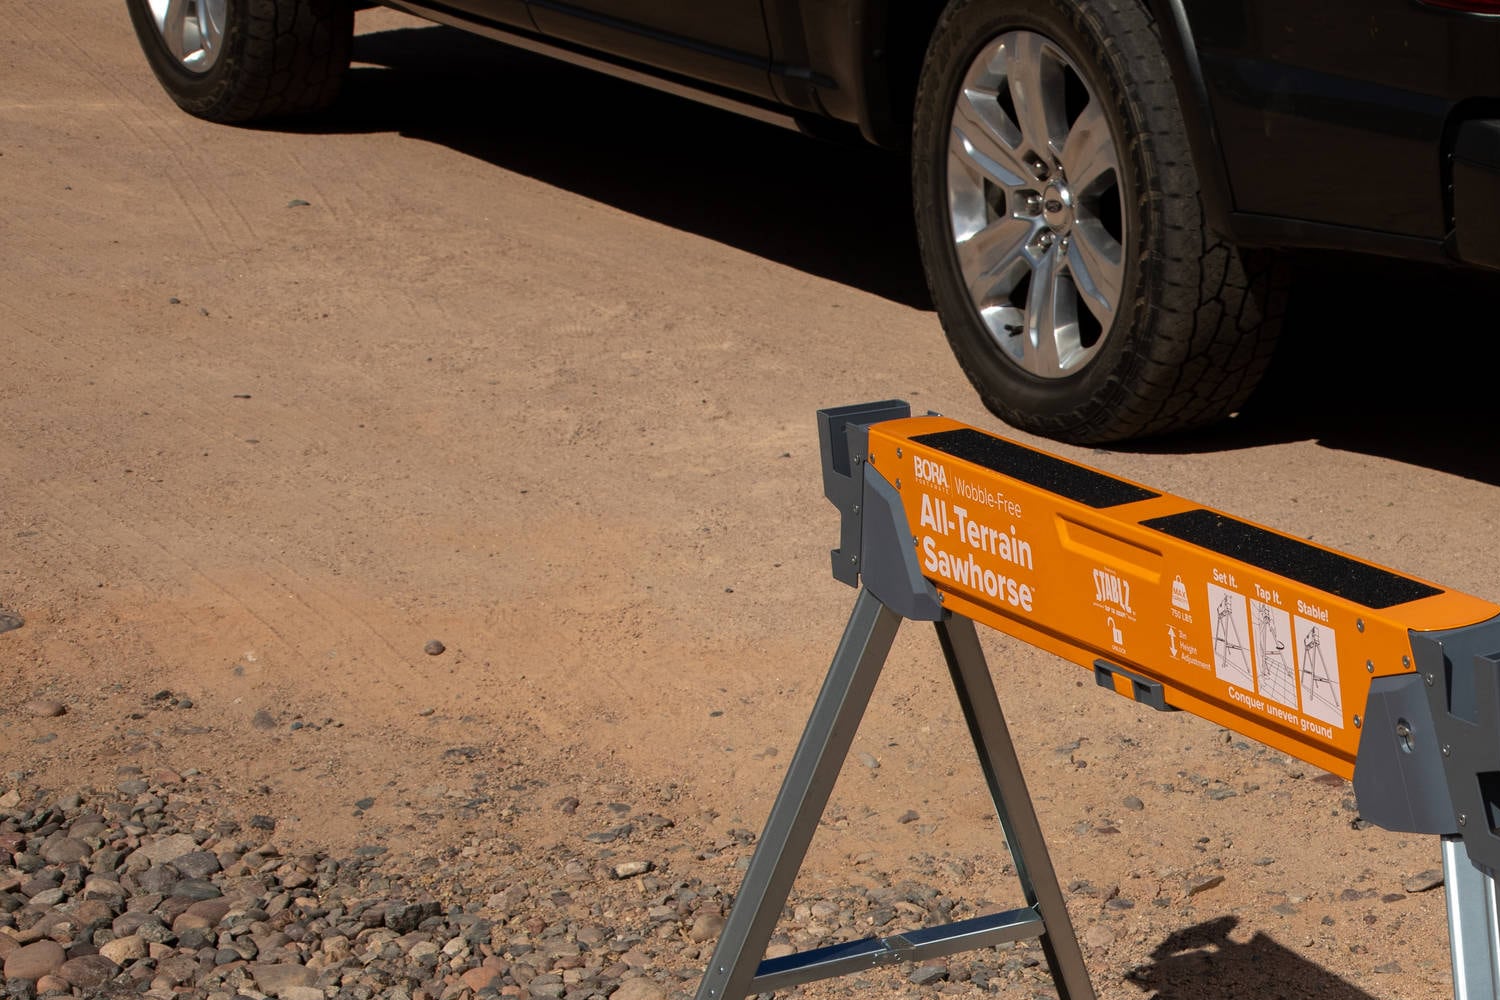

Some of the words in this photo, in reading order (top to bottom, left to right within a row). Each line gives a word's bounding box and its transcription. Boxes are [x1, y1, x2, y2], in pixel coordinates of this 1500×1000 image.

[913, 455, 948, 488] BORA
[954, 476, 1022, 518] Wobble-Free
[920, 493, 1033, 570] All-Terrain
[1212, 568, 1228, 585] Set
[1229, 574, 1238, 589] It.
[1254, 583, 1271, 602] Tap
[1272, 590, 1282, 605] It.
[1296, 599, 1329, 623] Stable!
[1228, 685, 1264, 711] Conquer
[1266, 703, 1299, 726] uneven
[1300, 717, 1333, 740] ground
